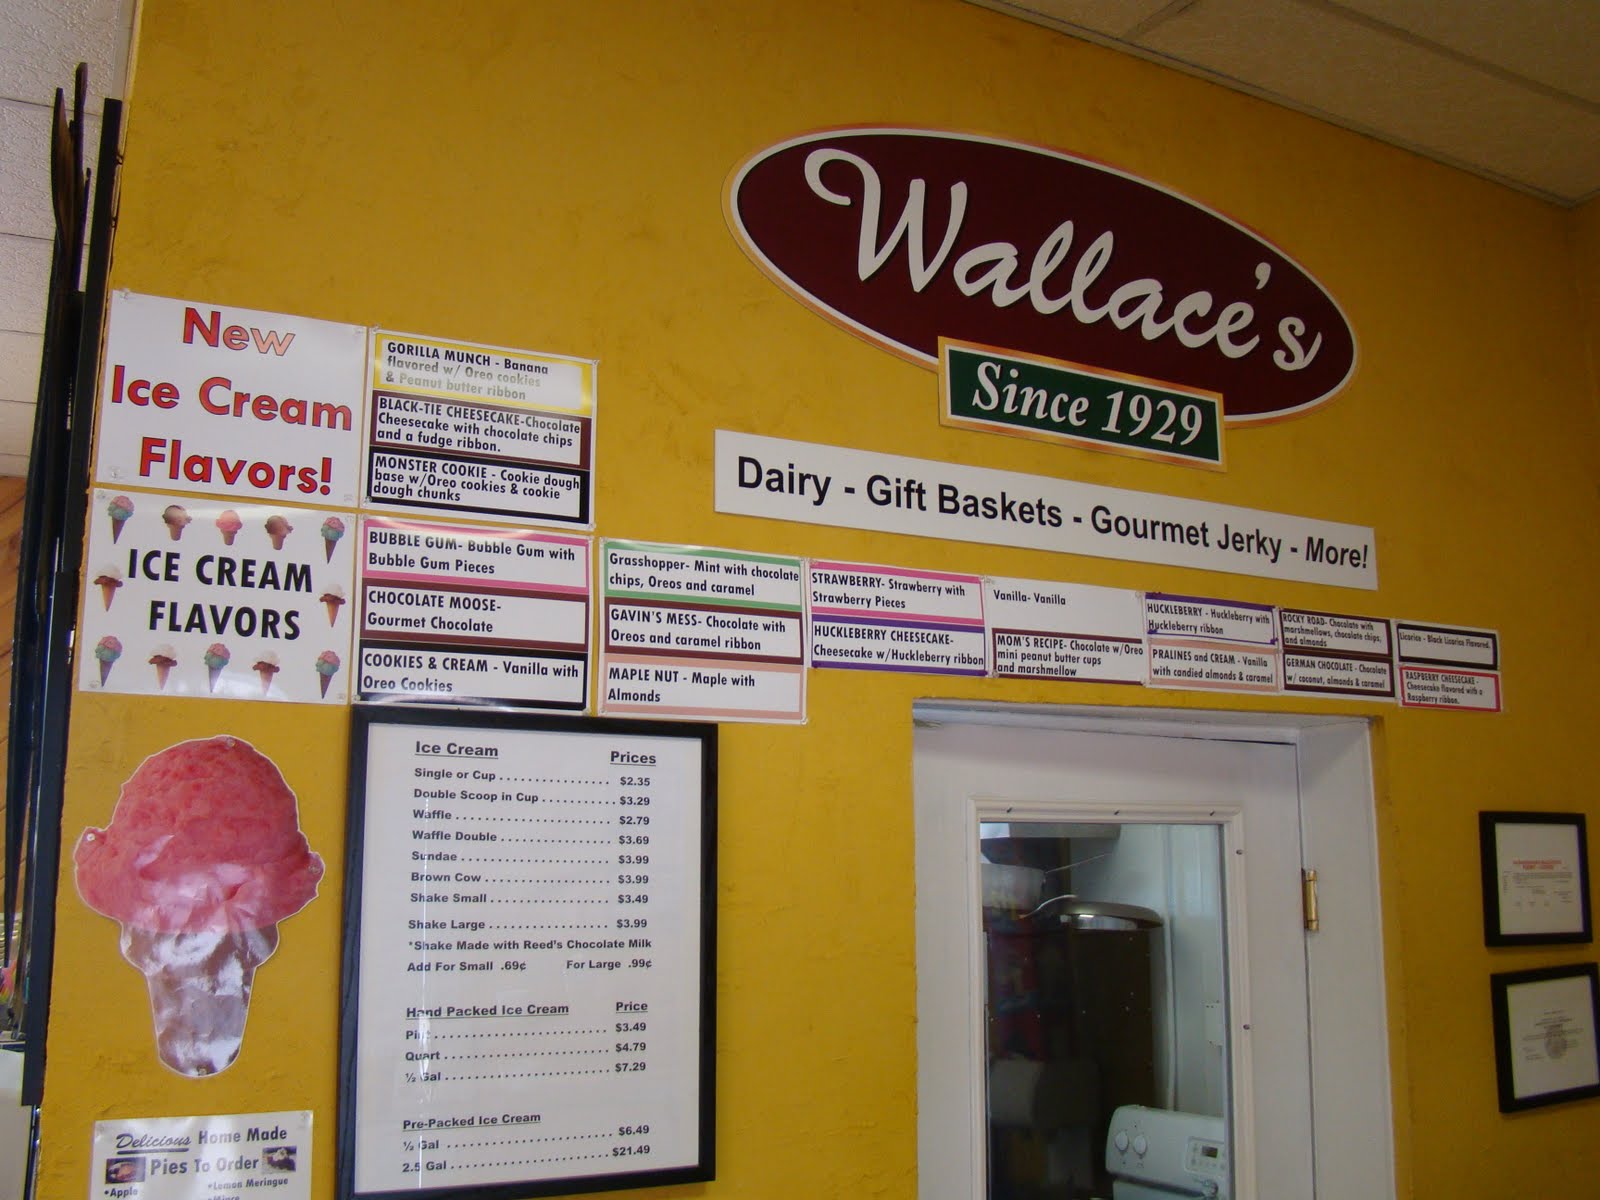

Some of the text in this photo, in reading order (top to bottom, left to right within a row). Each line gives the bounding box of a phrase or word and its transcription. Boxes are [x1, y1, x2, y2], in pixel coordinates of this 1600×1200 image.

[804, 147, 1322, 371] Wallace's
[183, 307, 296, 356] New
[388, 342, 439, 360] GORILLA
[444, 350, 490, 366] MUNCH
[504, 358, 548, 374] Banana
[112, 365, 352, 431] Ice Cream
[972, 360, 1203, 446] Since 1929
[379, 397, 580, 434] BLACK-TIE CHEESECAKE-Chocolate
[379, 412, 572, 448] Cheesecake with chocolate chips
[140, 437, 332, 495] Flavors!
[375, 455, 437, 473] MONSTER
[442, 463, 486, 478] COOKIE
[501, 470, 539, 484] Cookie
[544, 474, 579, 490] dough
[737, 454, 831, 506] Dairy
[866, 474, 927, 512] Gift
[938, 483, 1063, 528] Baskets
[1090, 506, 1209, 547] Gourmet
[1216, 523, 1282, 565] Jerky
[1305, 535, 1368, 569] More!
[370, 532, 574, 560] BUBBLE GUM- Bubble Gum with
[128, 549, 312, 592] ICE CREAM
[369, 552, 494, 574] Bubble Gum Pieces
[610, 553, 800, 581] Grasshopper- Mint with chocolate
[609, 573, 754, 595] chips, Oreos and caramel
[812, 572, 965, 596] STRAWBERRY- Strawberry with
[369, 590, 501, 611] CHOCOLATE MOOSE-
[813, 591, 905, 608] Strawberry Pieces
[994, 590, 1066, 605] Vanilla- Vanilla
[150, 600, 300, 640] FLAVORS
[368, 612, 492, 632] Gourmet Chocolate
[611, 608, 785, 632] GAVIN'S MESS- Chocolate with
[1147, 604, 1202, 616] HUCKLEBERRY
[1211, 609, 1252, 624] Huckleberry
[1256, 614, 1270, 624] with
[815, 625, 953, 644] HUCKLEBERRY CHEESECAKE-
[1147, 620, 1223, 634] Huckleberry ribbon
[814, 644, 983, 665] Cheesecake w/Huckleberry ribbon
[998, 635, 1143, 655] MOM'S RECIPE- Chocolate w/Oreo
[365, 654, 422, 668] COOKIES
[428, 657, 436, 669] &
[443, 658, 488, 672] CREAM
[503, 661, 548, 675] Vanilla
[553, 665, 578, 677] with
[1153, 649, 1192, 661] PRALINES
[1194, 653, 1208, 662] and
[1210, 653, 1235, 664] CREAM
[1242, 656, 1268, 667] Vanilla
[1286, 658, 1315, 668] GERMAN
[1318, 661, 1352, 671] CHOCOLATE
[1359, 664, 1386, 675] Chocolate
[609, 668, 649, 681] MAPLE
[655, 670, 678, 682] NUT
[692, 672, 727, 687] Maple
[731, 675, 754, 686] with
[608, 688, 660, 702] Almonds
[416, 741, 656, 766] Ice Cream Prices
[415, 768, 452, 780] Single
[473, 770, 496, 782] Cup
[620, 776, 650, 786] $2.35
[413, 810, 649, 825] Waffle $2.79
[412, 830, 649, 844] Waffle Double $3.69
[412, 851, 649, 864] Sundae $3.99
[412, 872, 648, 884] Brown Cow $3.99
[411, 893, 648, 904] Shake Small $3.49
[408, 919, 647, 931] Shake Large $3.99
[457, 941, 489, 950] Made
[494, 940, 519, 949] with
[524, 940, 562, 949] Reed's
[567, 940, 624, 948] Chocolate
[629, 939, 651, 948] Milk
[407, 1002, 648, 1019] Hand Packed Ice Cream Price
[406, 1042, 646, 1061] Quart $4.79
[403, 1114, 540, 1131] Pre-Packed Ice Cream
[114, 1126, 287, 1149] Delicious Home Made
[151, 1155, 259, 1175] Pies To Order
